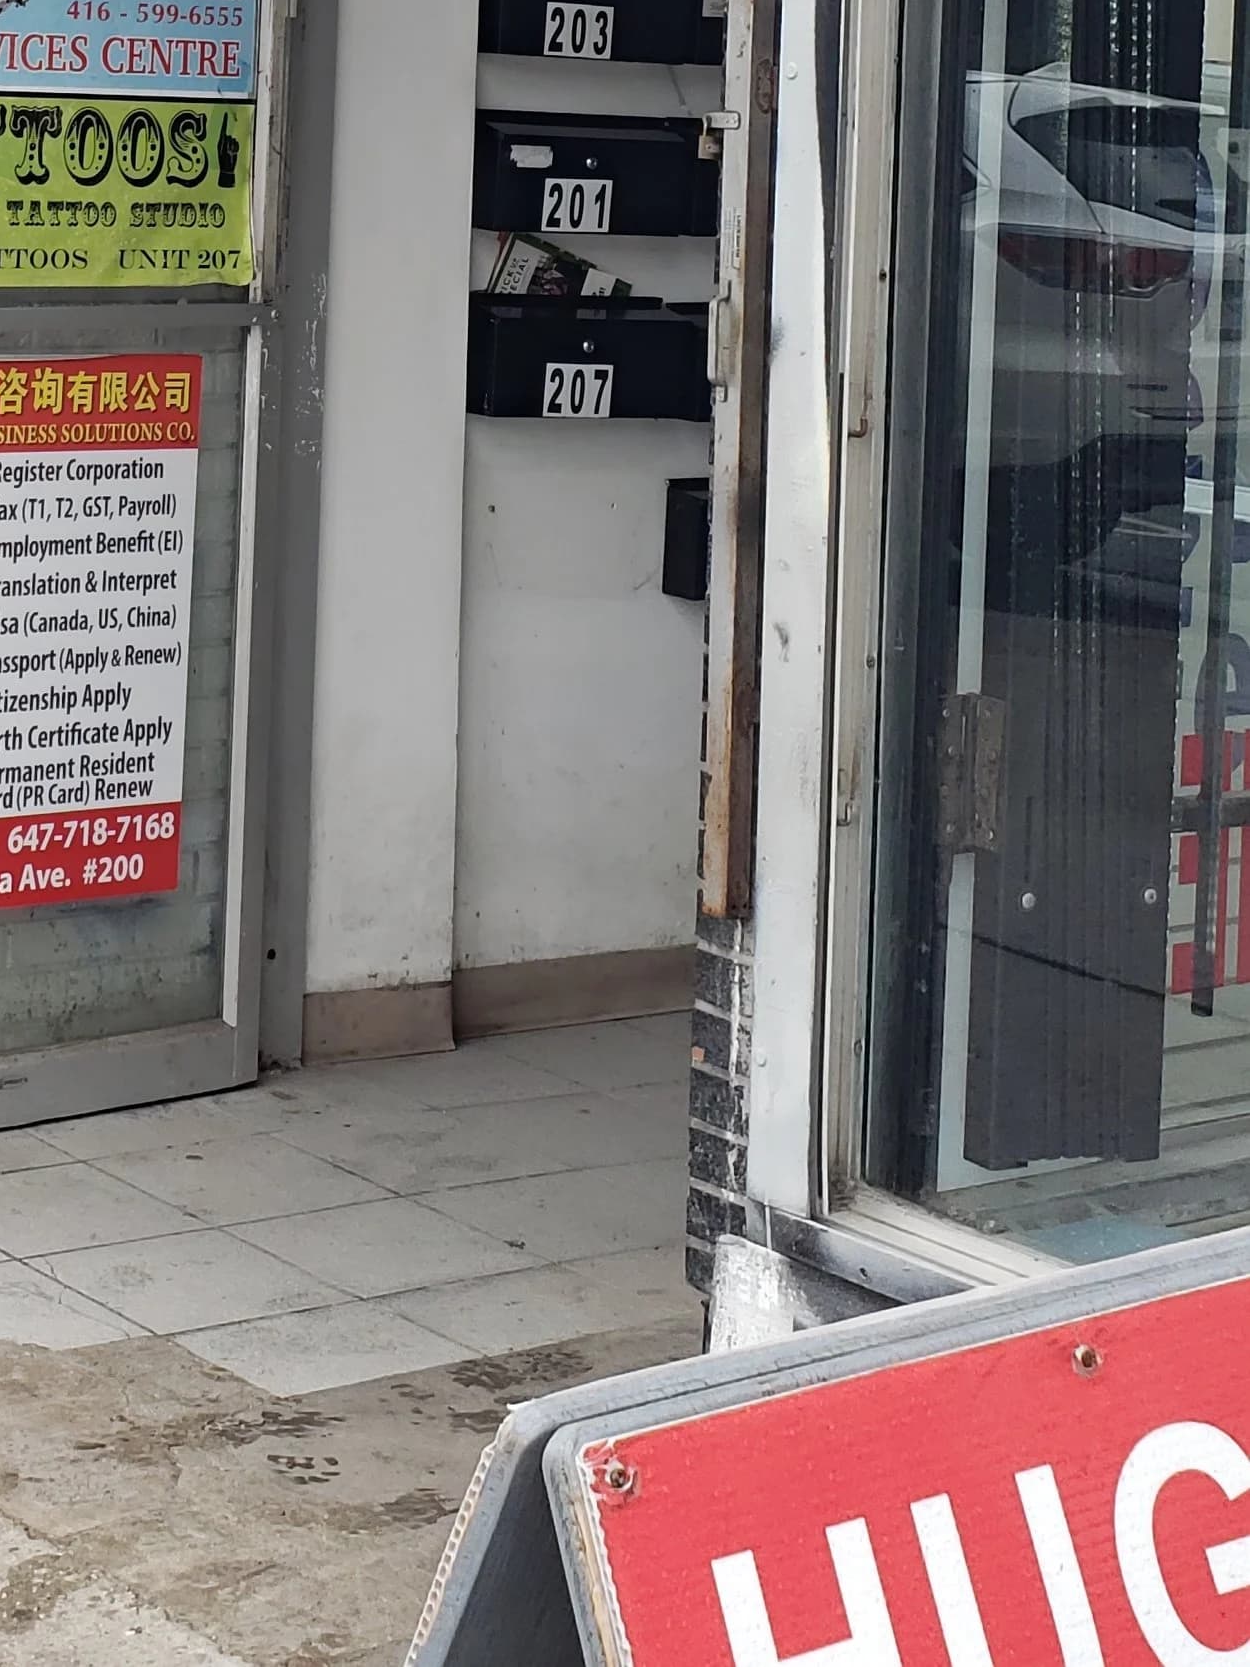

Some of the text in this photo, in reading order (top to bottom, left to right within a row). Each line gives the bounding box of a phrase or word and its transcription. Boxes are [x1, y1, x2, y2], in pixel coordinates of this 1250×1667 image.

[66, 0, 109, 22] 416
[135, 3, 243, 27] 599-6555
[548, 6, 609, 55] 203
[101, 38, 240, 78] CENTRE
[6, 199, 117, 228] TATTOO
[130, 199, 225, 229] STUDIO
[546, 183, 608, 230] 201
[119, 248, 191, 270] UNIT
[196, 248, 242, 271] 207
[547, 368, 609, 415] 207
[61, 422, 162, 444] SOLUTIONS
[166, 421, 195, 443] CO.
[65, 459, 165, 485] Corporation
[21, 497, 52, 524] (T1,
[55, 498, 79, 522] T2,
[82, 496, 114, 522] GST,
[117, 493, 177, 520] Payroll)
[96, 531, 155, 556] Benefit
[157, 530, 184, 555] (EI)
[84, 573, 97, 592] &
[101, 569, 178, 596] Interpret
[22, 610, 94, 637] (Canada,
[98, 609, 123, 632] US,
[126, 604, 177, 631] China)
[58, 646, 108, 672] (Apply
[110, 650, 121, 667] &
[124, 642, 182, 669] Renew)
[81, 682, 131, 709] Apply
[28, 723, 120, 751] Certificate
[123, 717, 173, 746] Apply
[80, 752, 155, 779] Resident
[16, 785, 45, 811] (PR
[48, 782, 90, 807] Card)
[94, 779, 153, 801] Renew
[7, 812, 175, 854] 647-718-7168
[18, 862, 70, 892] Ave.
[82, 853, 144, 887] #200
